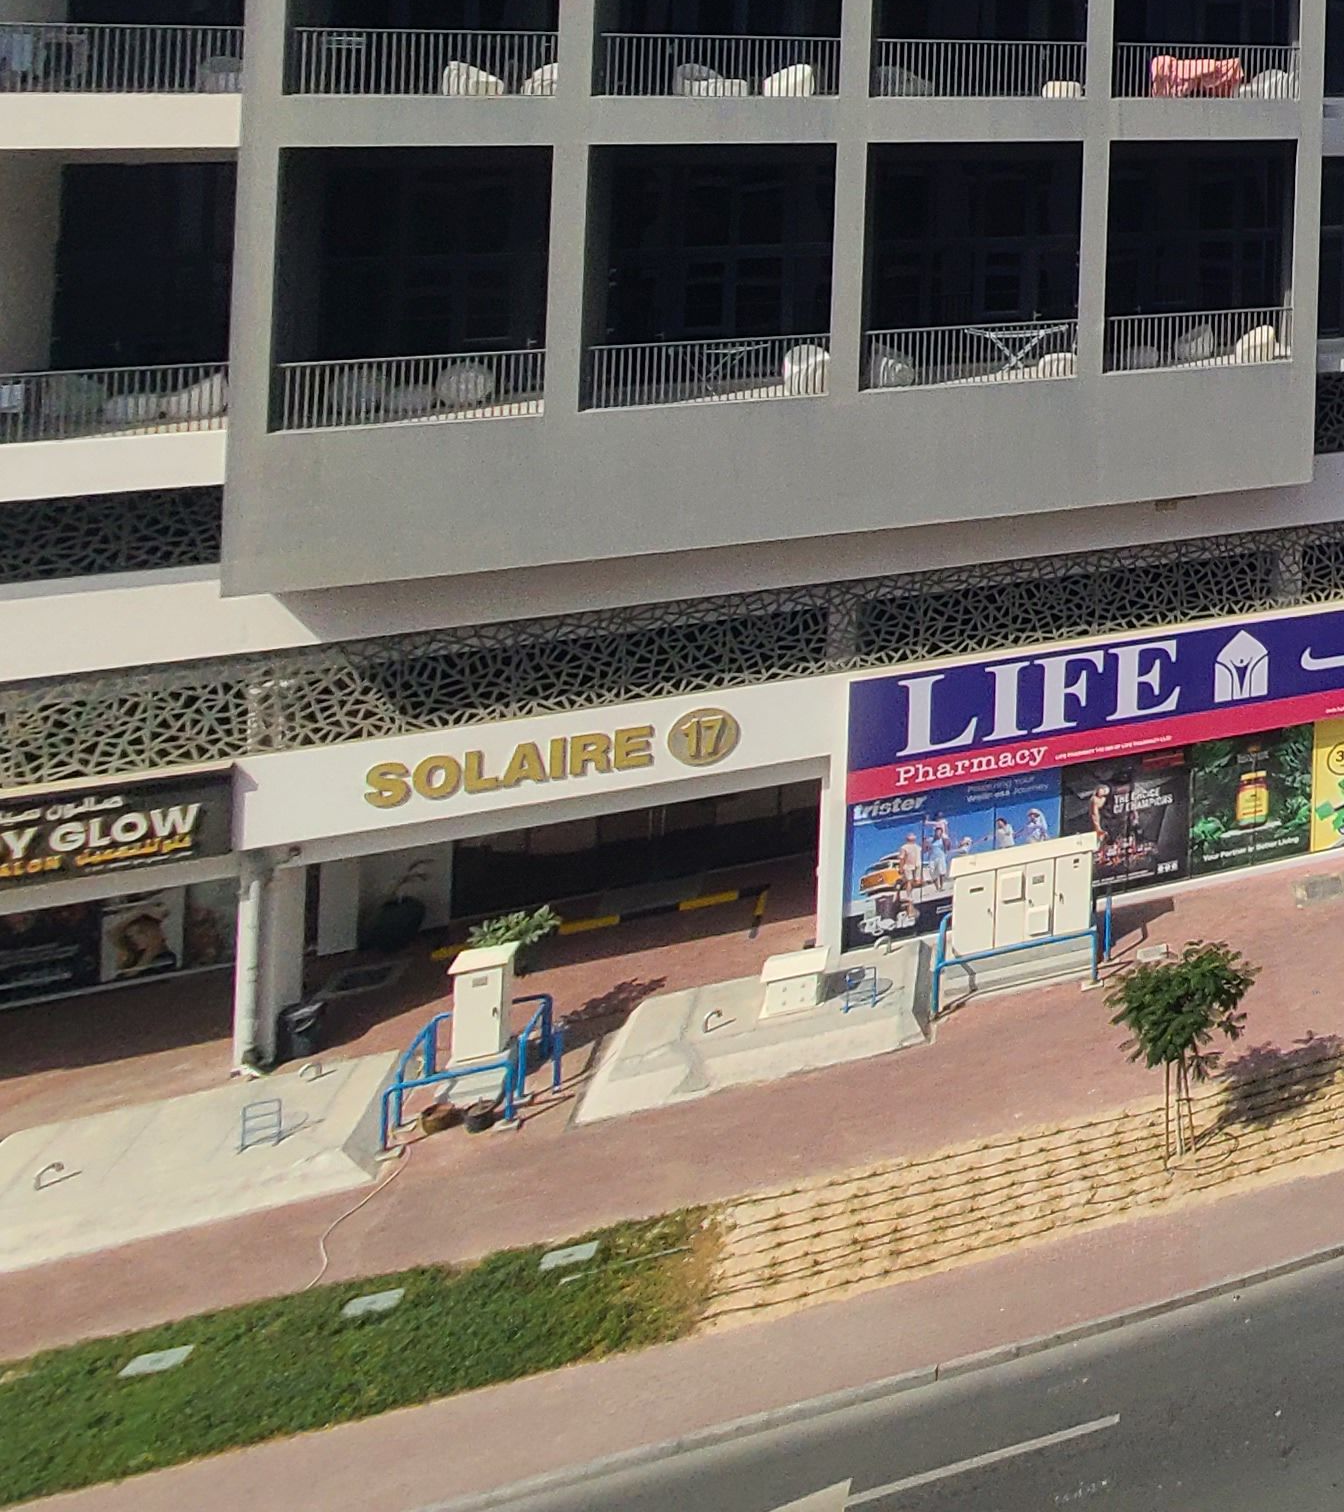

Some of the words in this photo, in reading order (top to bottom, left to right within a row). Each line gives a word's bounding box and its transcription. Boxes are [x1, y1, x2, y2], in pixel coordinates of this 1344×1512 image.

[896, 640, 1181, 757] LIFE
[364, 725, 656, 809] SOLAIRE
[681, 717, 727, 759] 17
[895, 746, 1048, 787] Pharmacy
[50, 803, 201, 853] GLOW
[854, 795, 928, 820] trister
